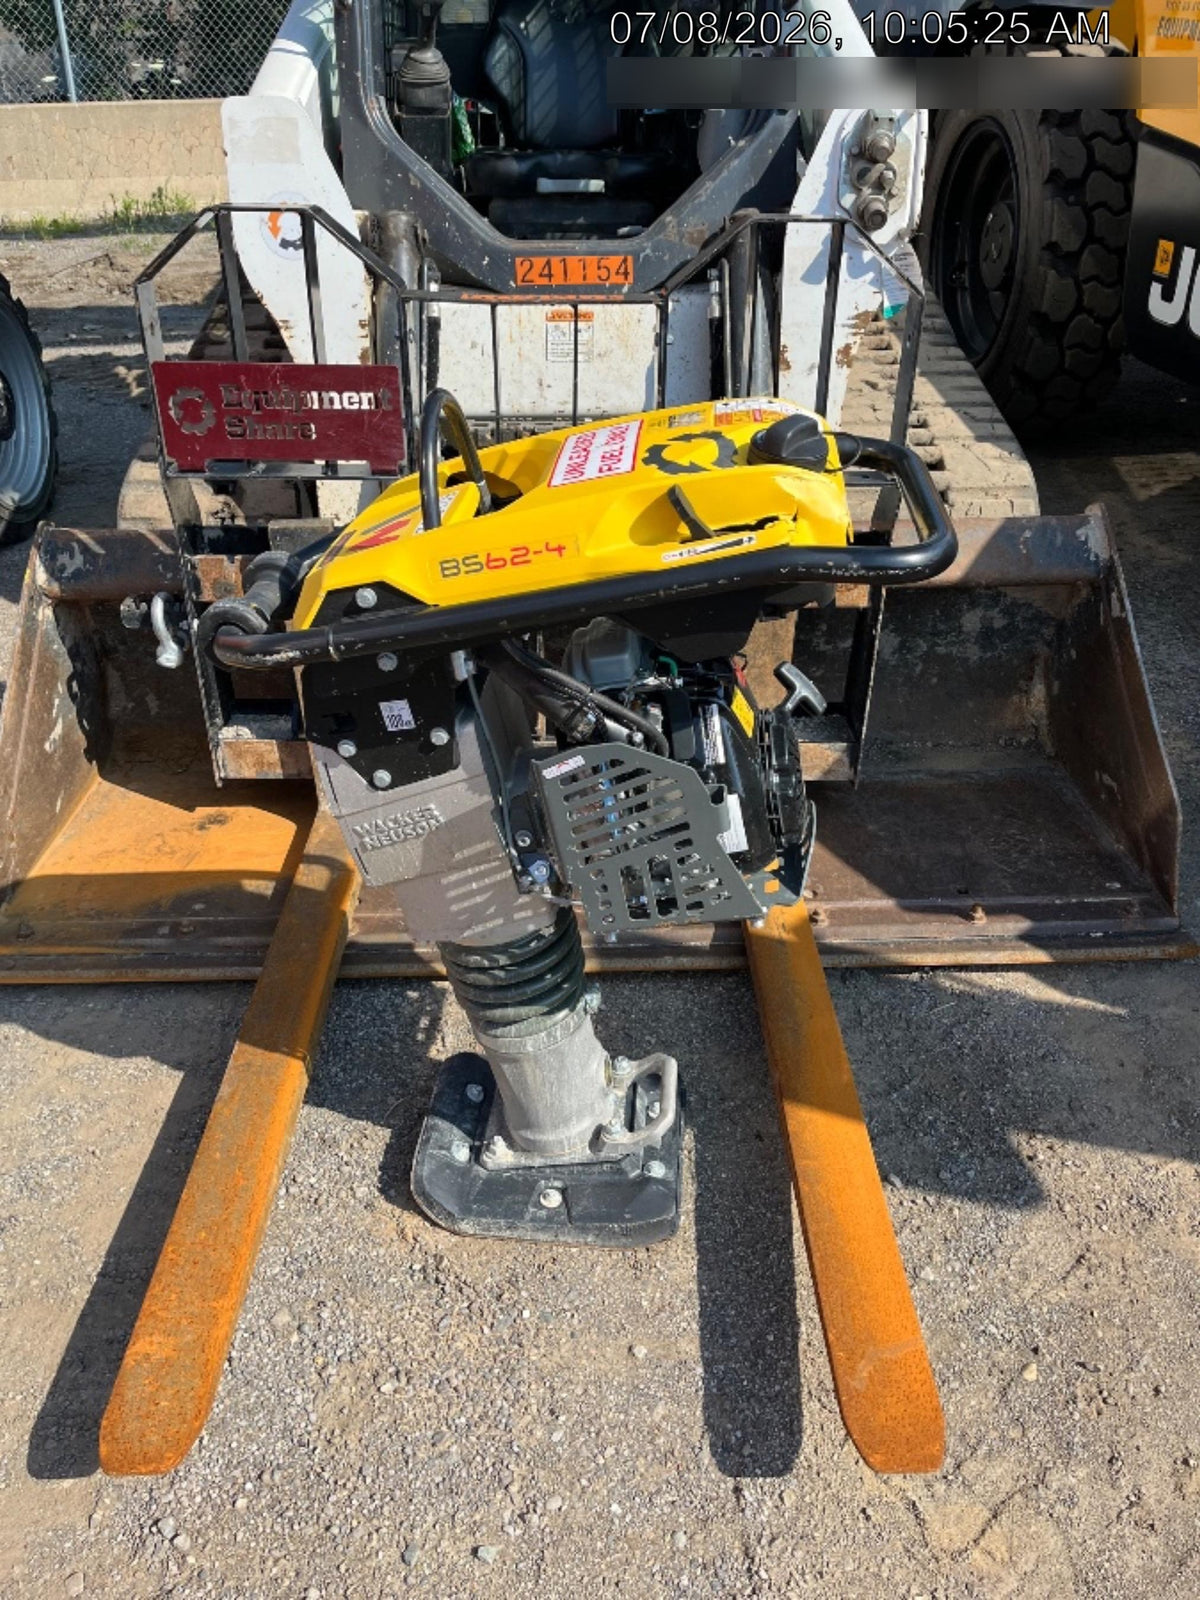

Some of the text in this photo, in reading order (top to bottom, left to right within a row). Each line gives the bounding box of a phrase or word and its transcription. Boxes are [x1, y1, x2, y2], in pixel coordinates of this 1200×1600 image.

[519, 255, 631, 283] 241154
[219, 384, 394, 415] Equipment
[224, 415, 318, 441] Share
[598, 446, 625, 474] FUEL
[438, 541, 567, 579] BS62-4
[352, 803, 441, 838] WACKER
[359, 814, 447, 851] NEUSON
